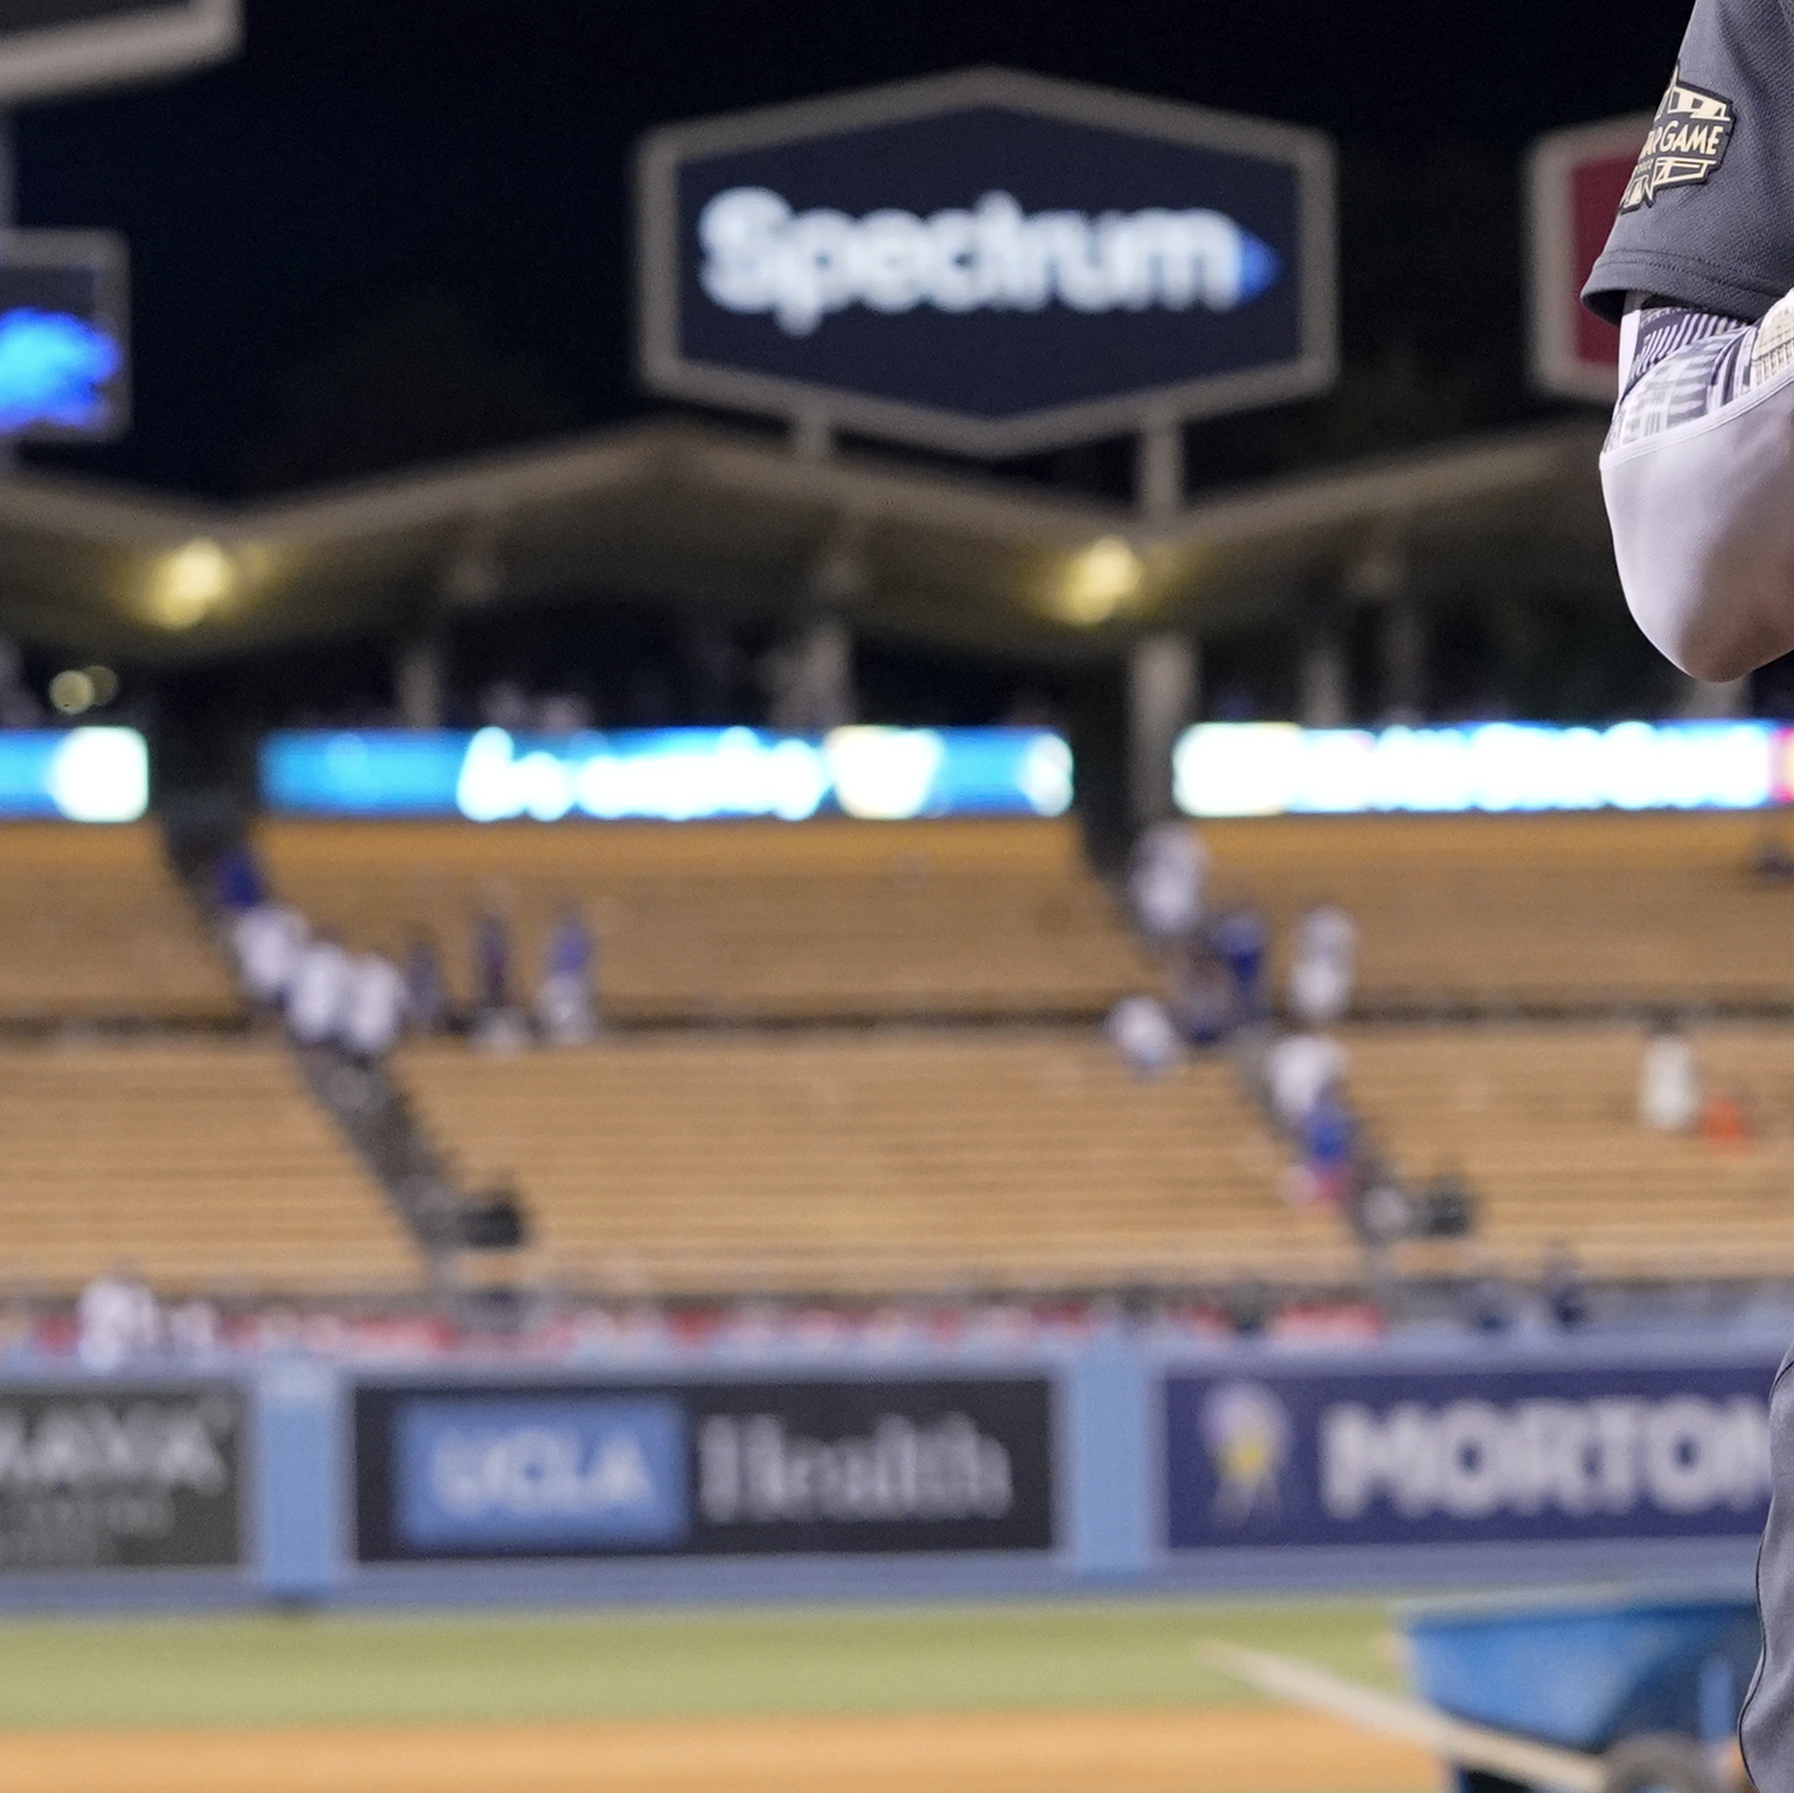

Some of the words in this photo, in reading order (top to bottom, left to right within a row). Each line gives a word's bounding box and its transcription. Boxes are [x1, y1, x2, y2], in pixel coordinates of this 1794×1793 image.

[1660, 120, 1724, 155] GAME
[697, 186, 1243, 338] Spectrum
[431, 1425, 657, 1516] UCLA
[699, 1410, 1016, 1524] Health
